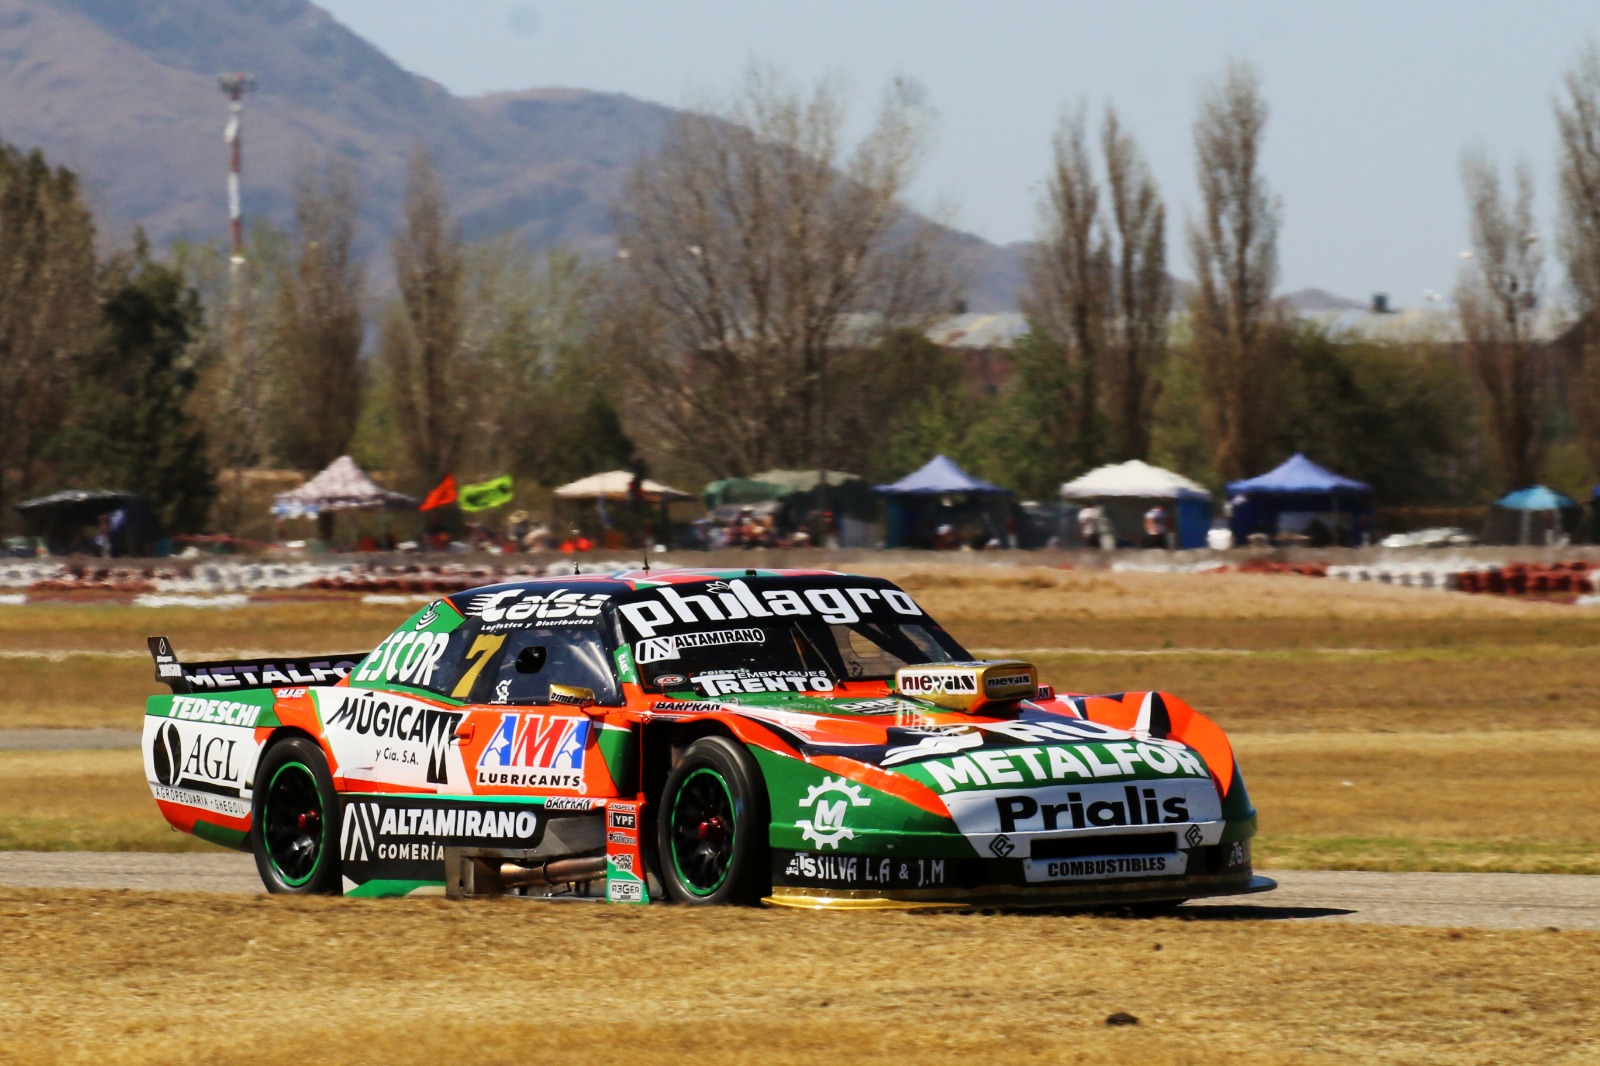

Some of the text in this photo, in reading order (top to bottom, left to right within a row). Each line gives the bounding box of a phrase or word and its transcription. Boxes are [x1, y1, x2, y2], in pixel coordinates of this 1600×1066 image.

[481, 588, 611, 622] Calsa
[618, 579, 922, 638] philagro
[675, 628, 764, 648] ALTAMIRANO
[355, 631, 450, 686] ESCOR
[451, 632, 508, 698] 7
[690, 673, 834, 697] TRENTO
[737, 670, 827, 680] EMBRAGUES
[168, 695, 262, 727] TEDESCHI
[326, 691, 426, 743] MÚGICA
[655, 701, 721, 712] BARPRAN
[375, 748, 382, 761] y
[402, 750, 419, 765] S.A.
[478, 714, 591, 770] AMA
[182, 733, 240, 783] AGL
[921, 742, 1210, 793] METALFOR
[478, 772, 581, 787] LUBRICANTS
[156, 786, 209, 807] AGROPECUARIA
[995, 785, 1190, 833] Prialis
[379, 807, 537, 839] ALTAMIRANO
[615, 815, 634, 826] YPF
[378, 841, 445, 861] GOMERÍA
[817, 855, 858, 883] SILVA
[899, 863, 910, 880] &
[1047, 856, 1166, 877] COMBUSTIBLES
